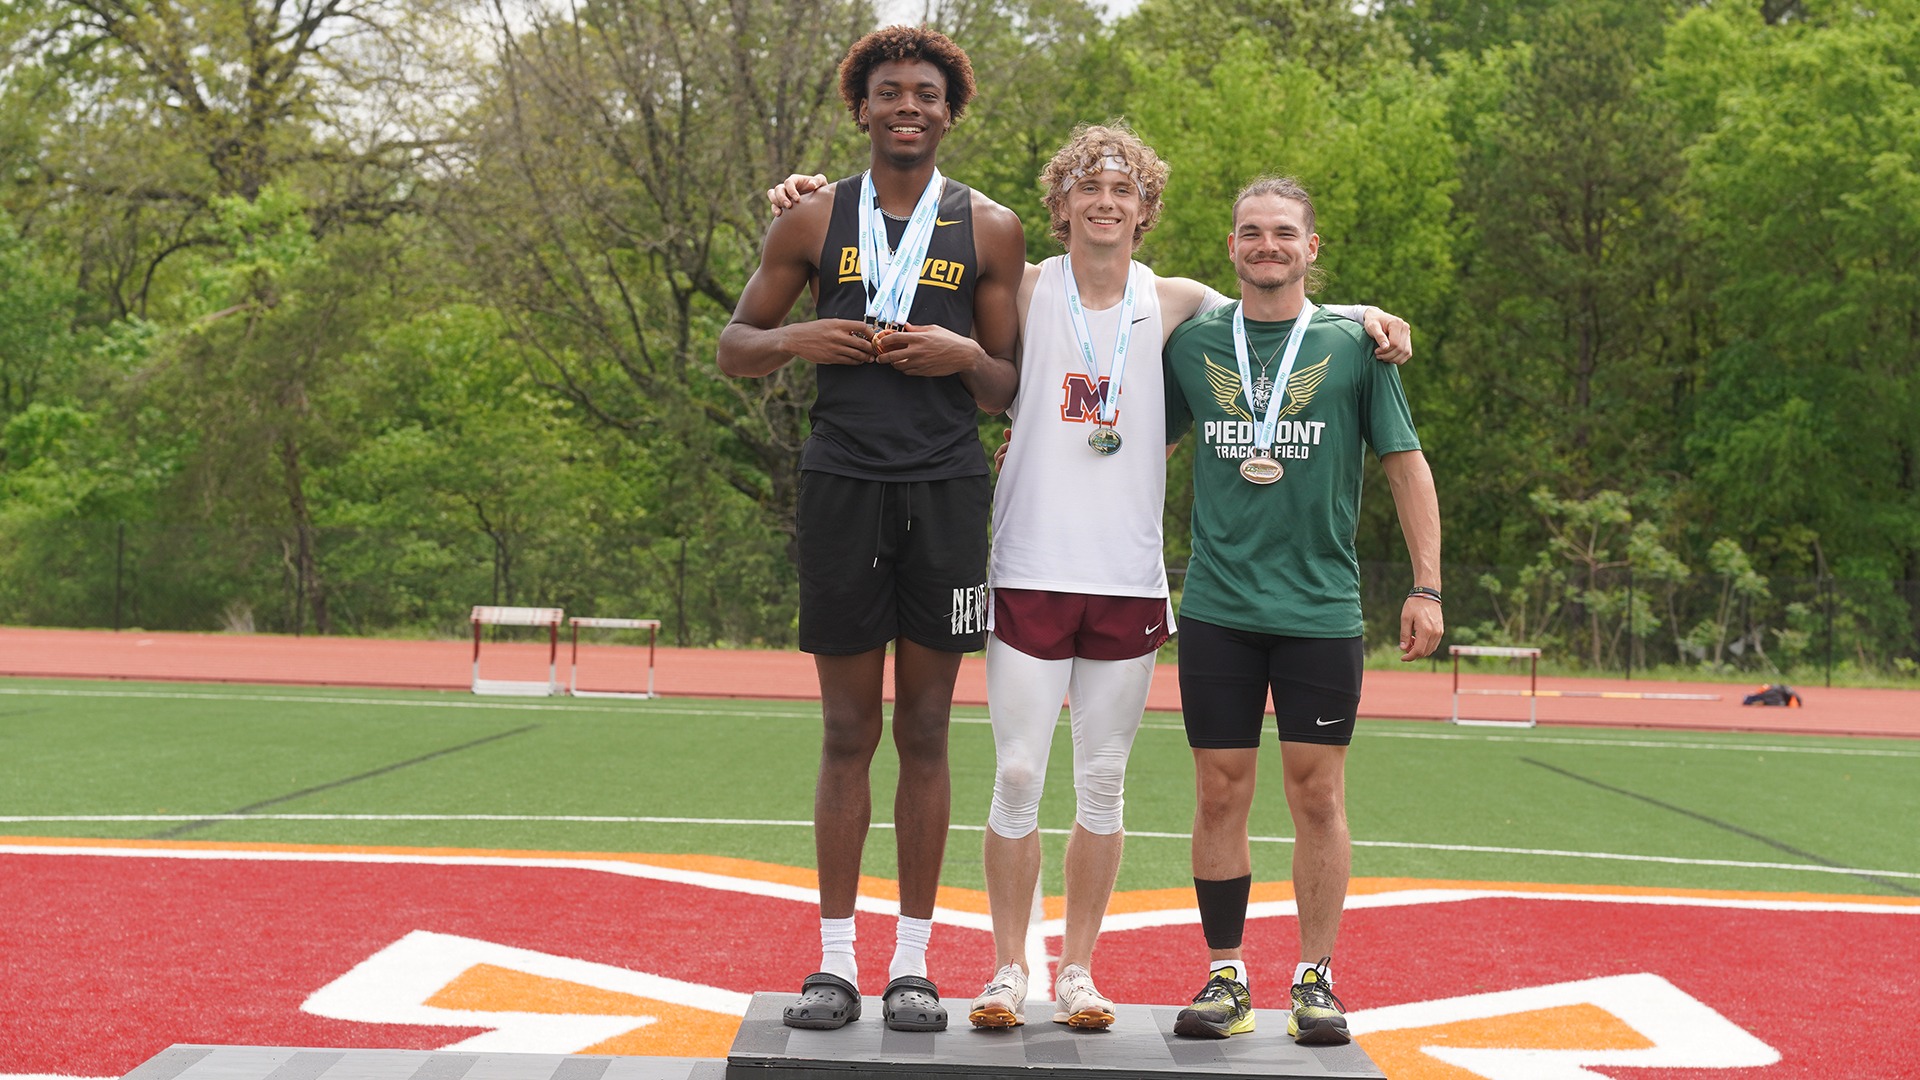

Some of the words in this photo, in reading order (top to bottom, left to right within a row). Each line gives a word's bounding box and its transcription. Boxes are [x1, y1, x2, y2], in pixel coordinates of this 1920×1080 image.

[1060, 373, 1122, 426] M
[1204, 421, 1326, 445] PIEDONT
[1215, 446, 1255, 458] TRACK
[1275, 446, 1309, 459] FIELD
